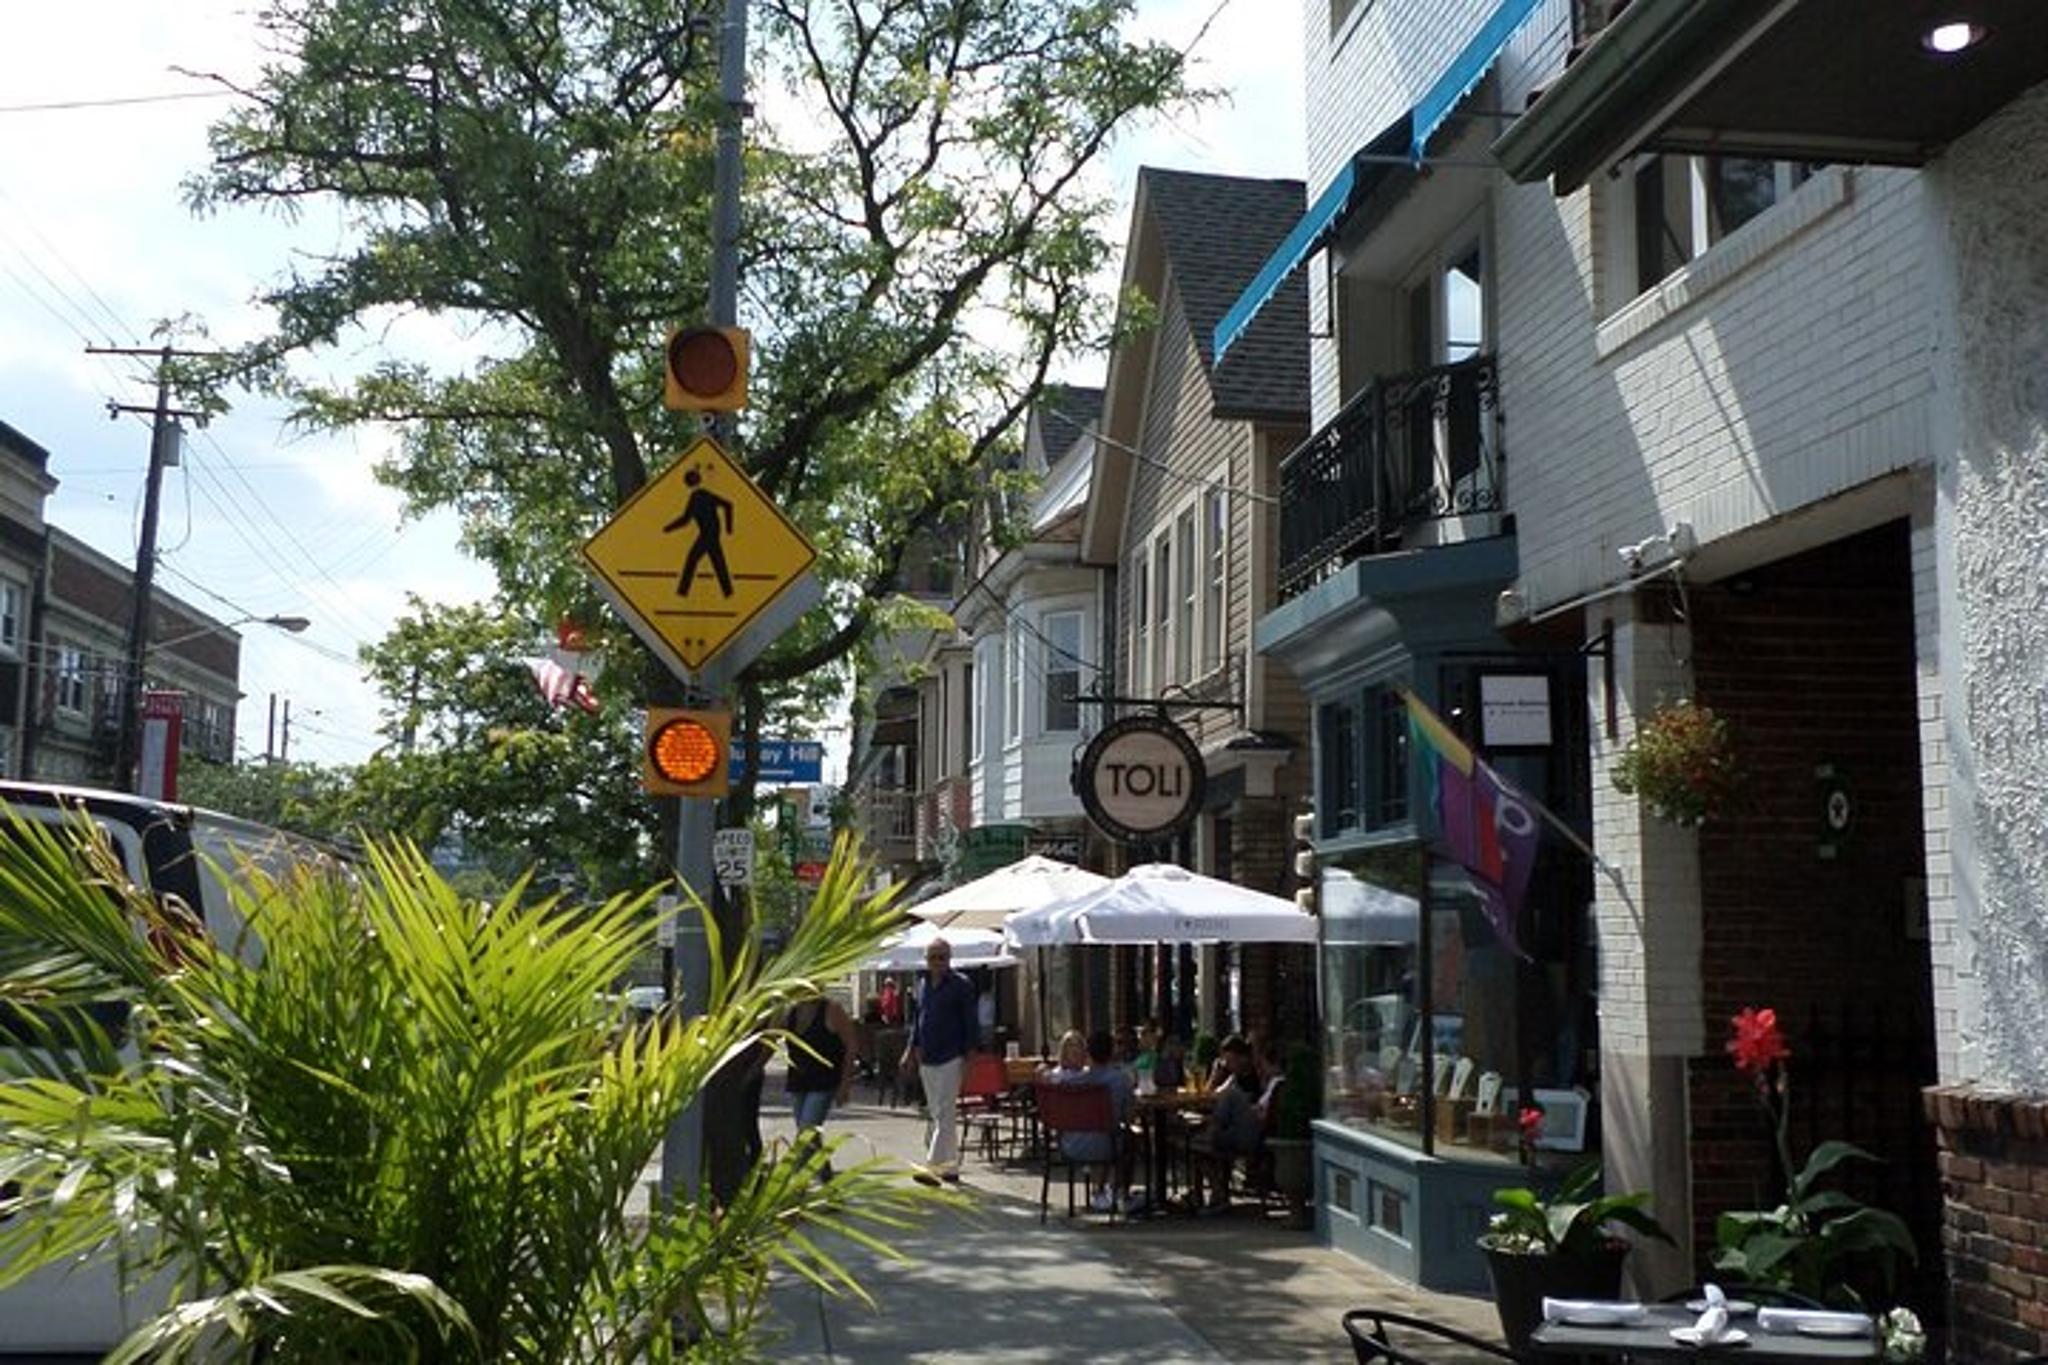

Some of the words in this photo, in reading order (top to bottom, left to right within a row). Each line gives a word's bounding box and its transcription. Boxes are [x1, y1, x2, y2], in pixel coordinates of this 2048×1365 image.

[789, 745, 818, 762] Hill
[1106, 764, 1182, 796] TOLI
[719, 859, 748, 879] 25
